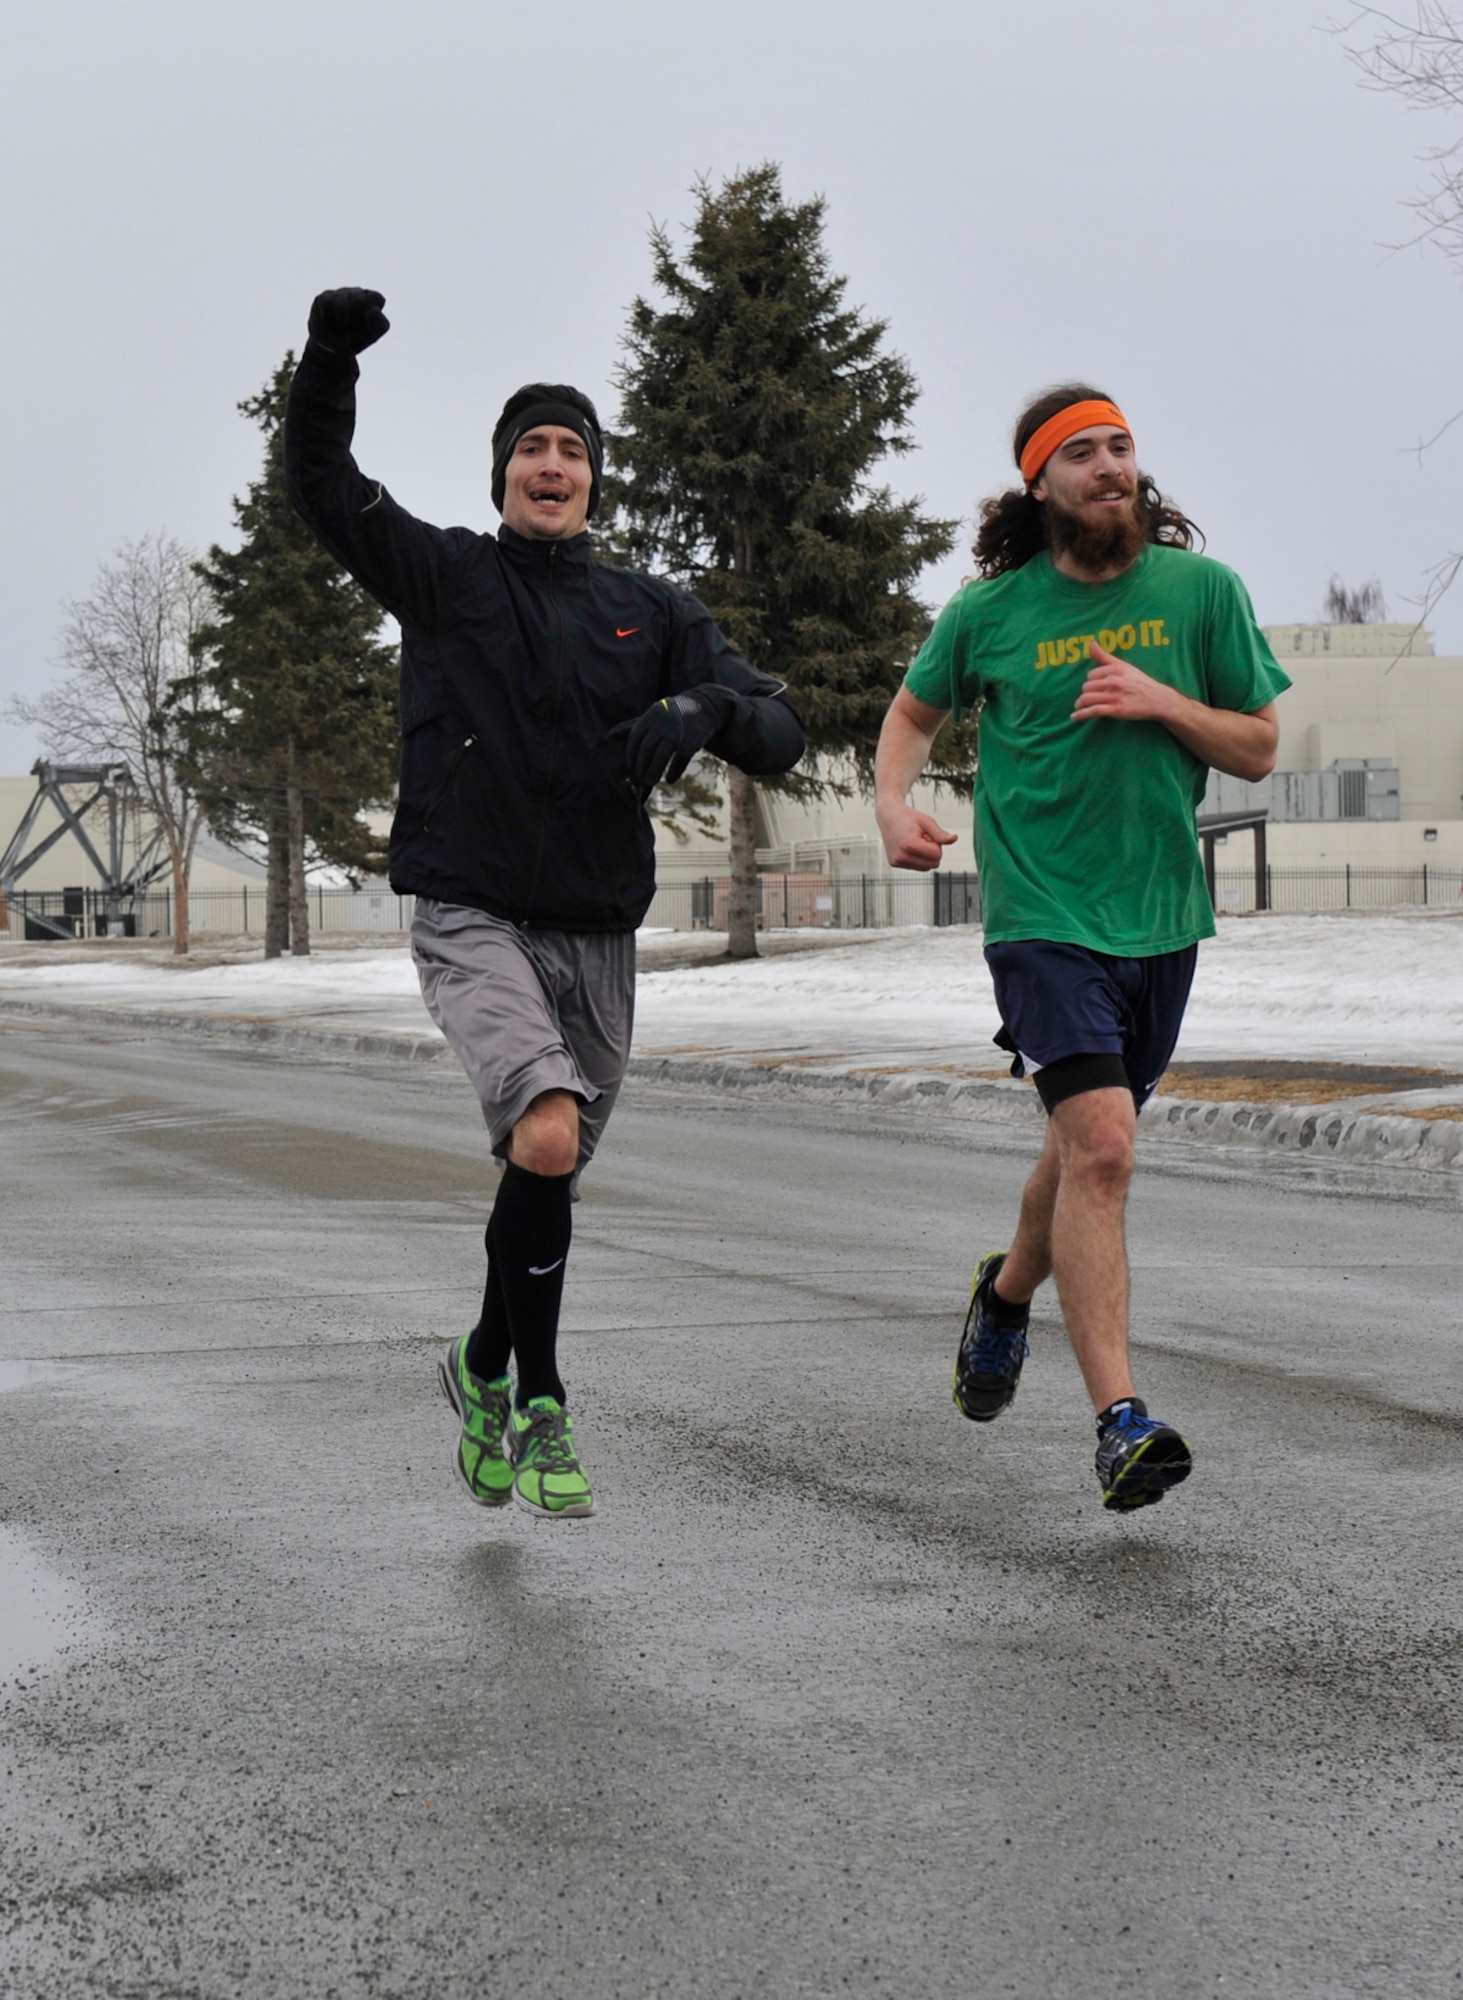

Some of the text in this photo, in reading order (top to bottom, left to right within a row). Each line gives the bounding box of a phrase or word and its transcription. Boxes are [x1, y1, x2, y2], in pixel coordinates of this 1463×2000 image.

[1035, 620, 1170, 669] JUST DO IT.
